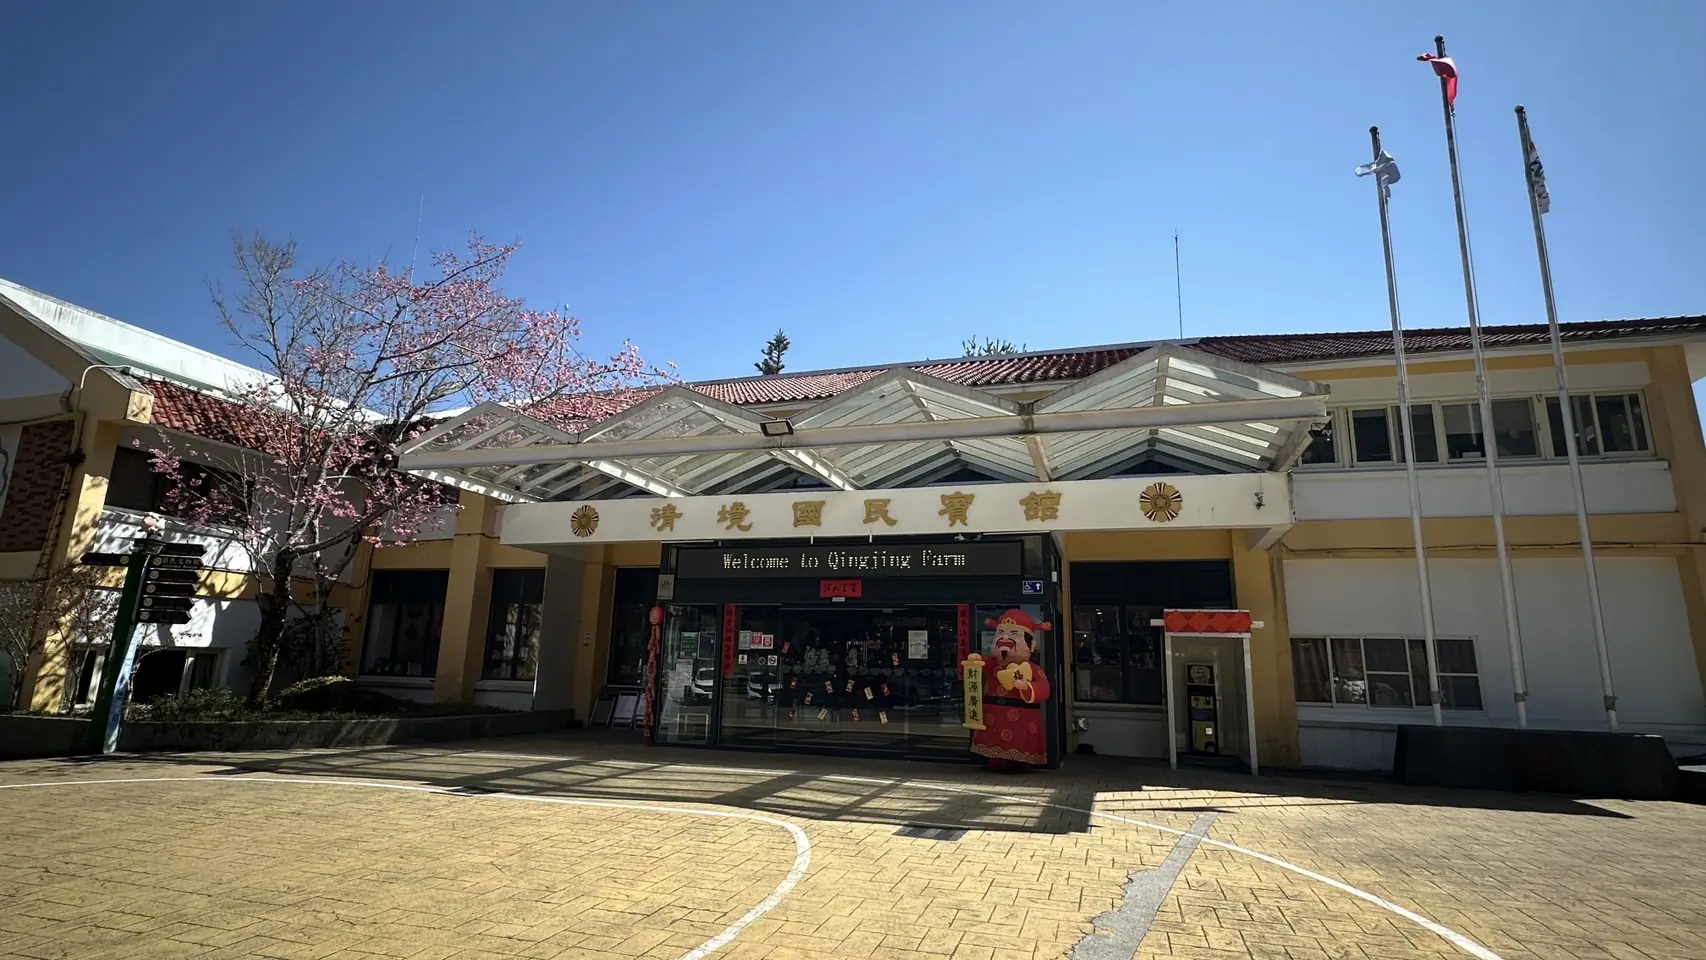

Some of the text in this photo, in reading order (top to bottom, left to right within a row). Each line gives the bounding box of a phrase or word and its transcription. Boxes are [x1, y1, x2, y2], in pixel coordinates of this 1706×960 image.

[722, 553, 789, 569] Welcome
[800, 553, 819, 568] to
[827, 551, 911, 570] Qingjing
[967, 668, 980, 722] 財源廣進
